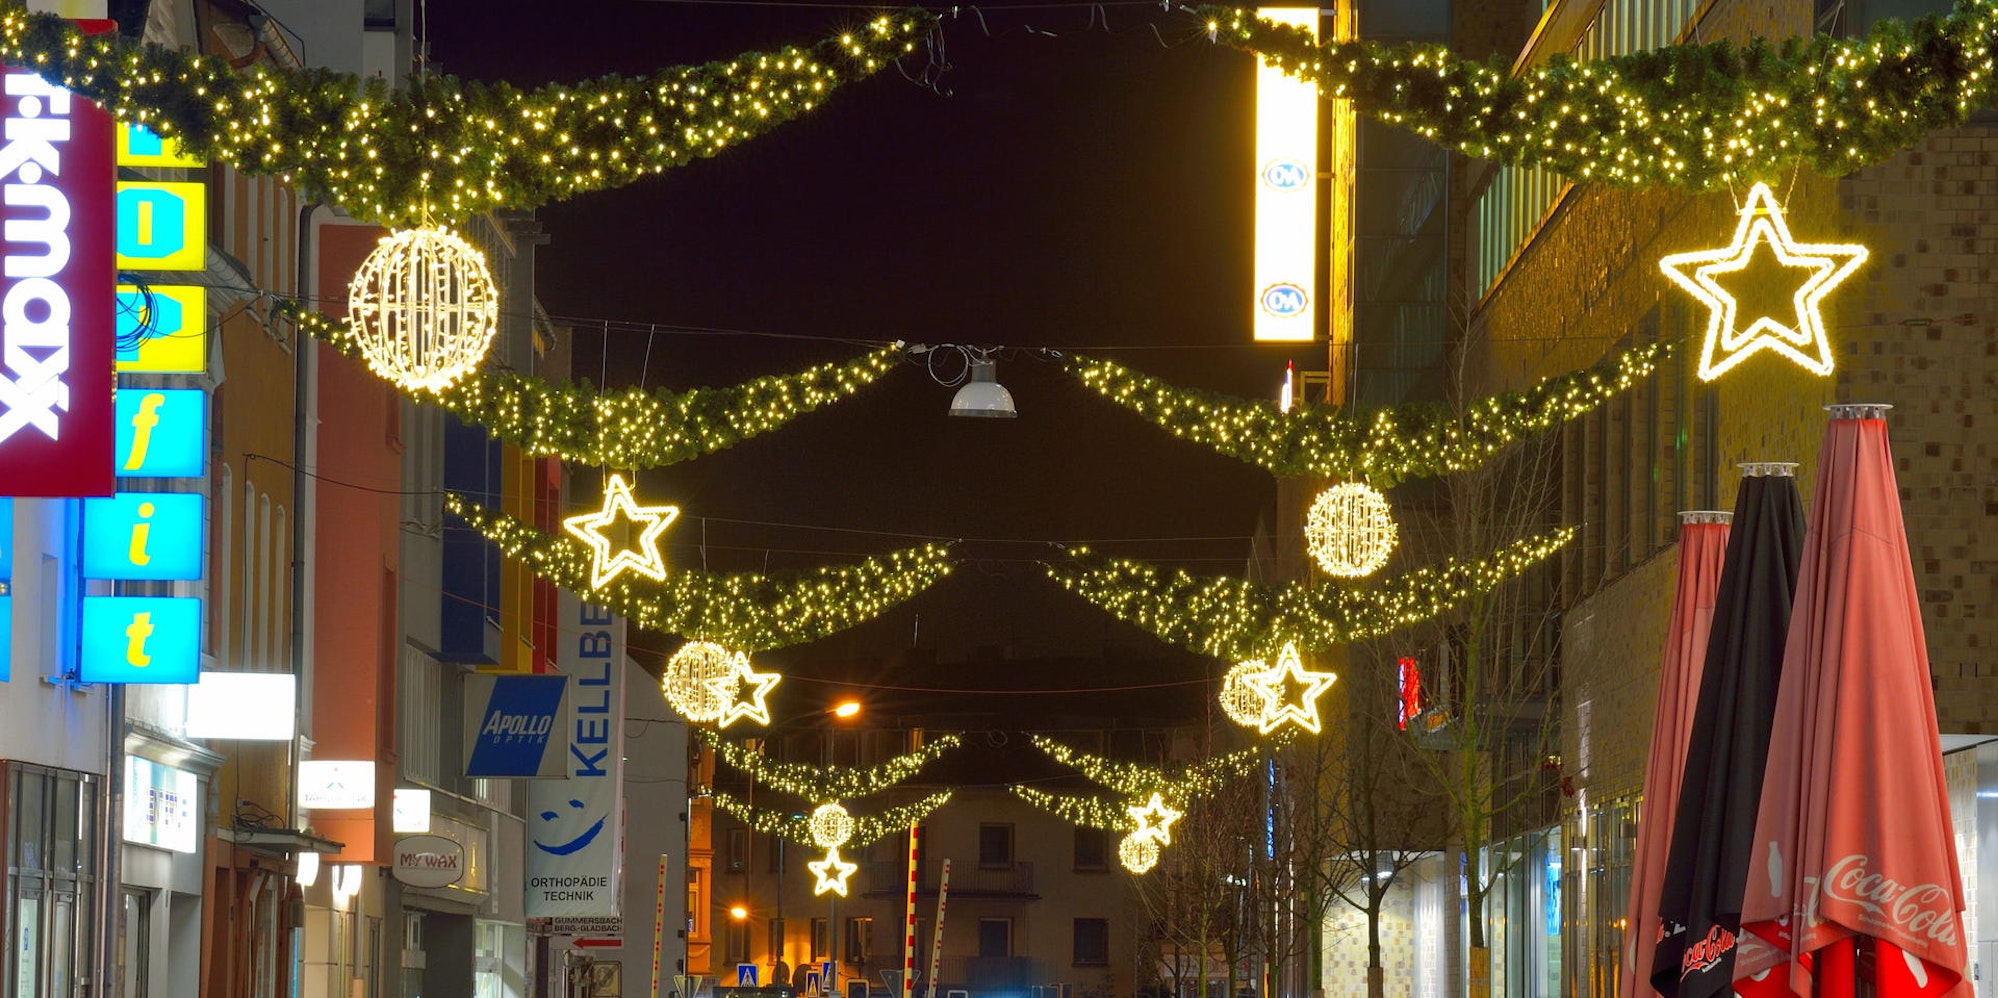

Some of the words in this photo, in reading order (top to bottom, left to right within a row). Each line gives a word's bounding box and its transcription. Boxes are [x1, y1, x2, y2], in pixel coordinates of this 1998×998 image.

[123, 393, 166, 667] fit
[482, 710, 552, 735] APOLLO
[493, 735, 546, 744] OPTIK
[400, 853, 422, 867] MY
[425, 855, 457, 868] WAX
[531, 875, 608, 887] ORTHOPÄDIE
[544, 891, 594, 901] TECHNIK
[1823, 854, 1957, 946] Coca-Cola
